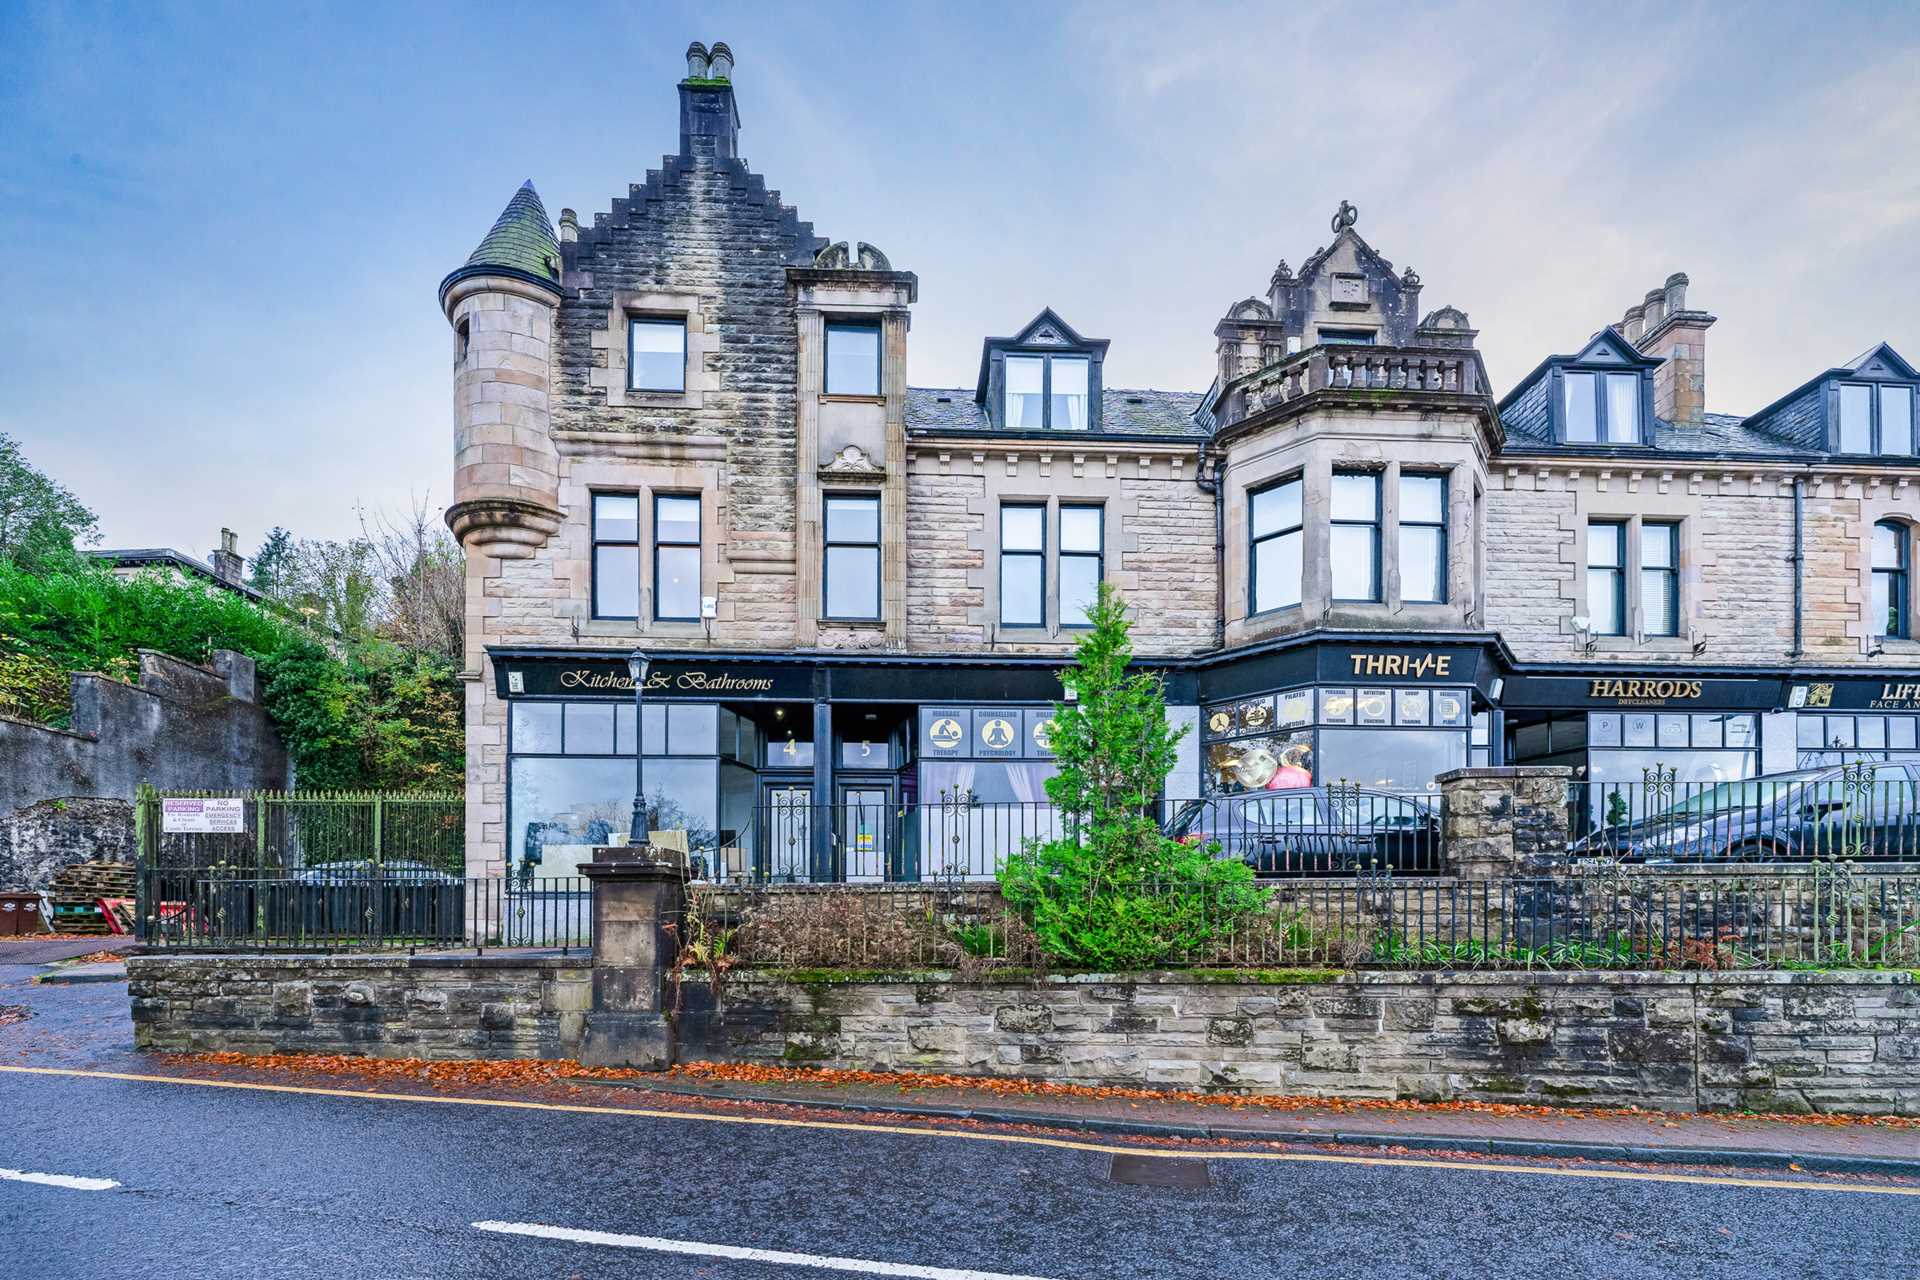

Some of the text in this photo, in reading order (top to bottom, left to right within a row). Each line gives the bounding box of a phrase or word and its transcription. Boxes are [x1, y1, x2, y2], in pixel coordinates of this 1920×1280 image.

[1351, 653, 1451, 677] THRIVE
[560, 670, 774, 690] Kitchen & Bathrooms
[1591, 680, 1702, 698] HARRODS
[1870, 700, 1900, 708] FACE
[783, 739, 796, 756] 4
[861, 740, 871, 757] 5
